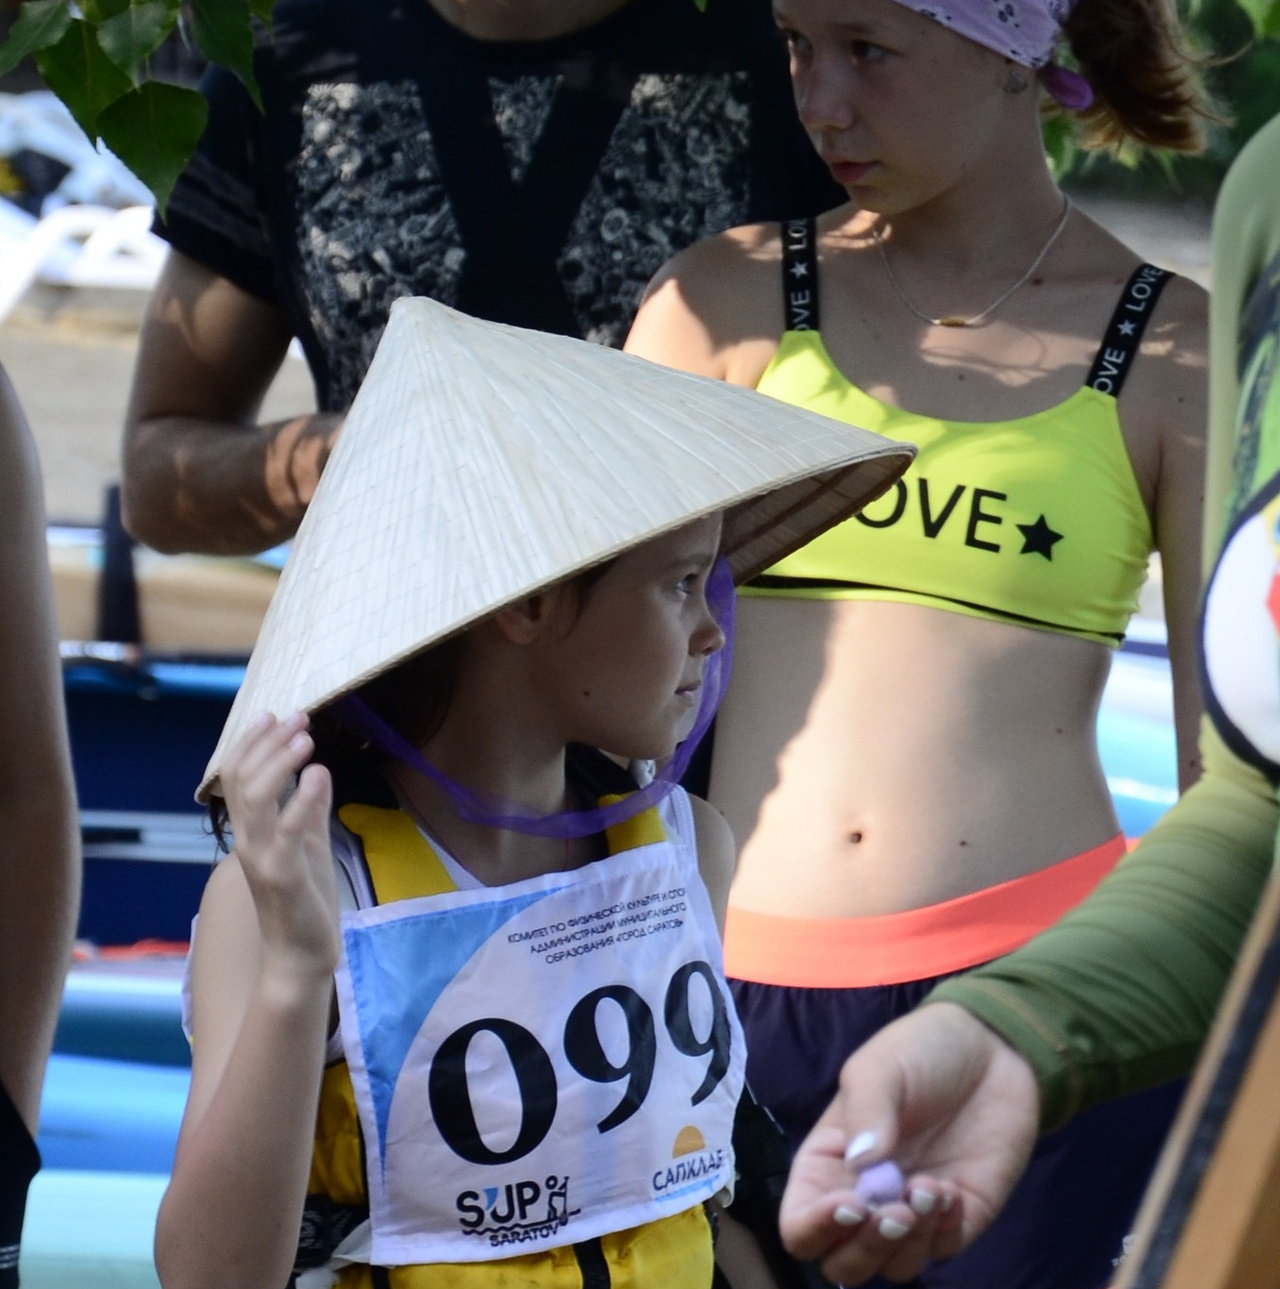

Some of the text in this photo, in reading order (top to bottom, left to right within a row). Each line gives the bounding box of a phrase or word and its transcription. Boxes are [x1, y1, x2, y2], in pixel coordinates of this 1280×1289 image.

[1092, 347, 1126, 395] OVE
[854, 475, 1009, 554] OVE
[507, 926, 549, 944] КОМИТЕТ
[550, 922, 567, 934] ПО
[567, 902, 626, 928] ФИЗИЧЕСКОЙ
[667, 887, 686, 900] СПО
[530, 920, 617, 955] АДМИНИСТРАЦИИ
[545, 935, 615, 965] ОБРАЗОВАНИЯ
[428, 960, 731, 1166] 099
[489, 1223, 559, 1248] SARATOV
